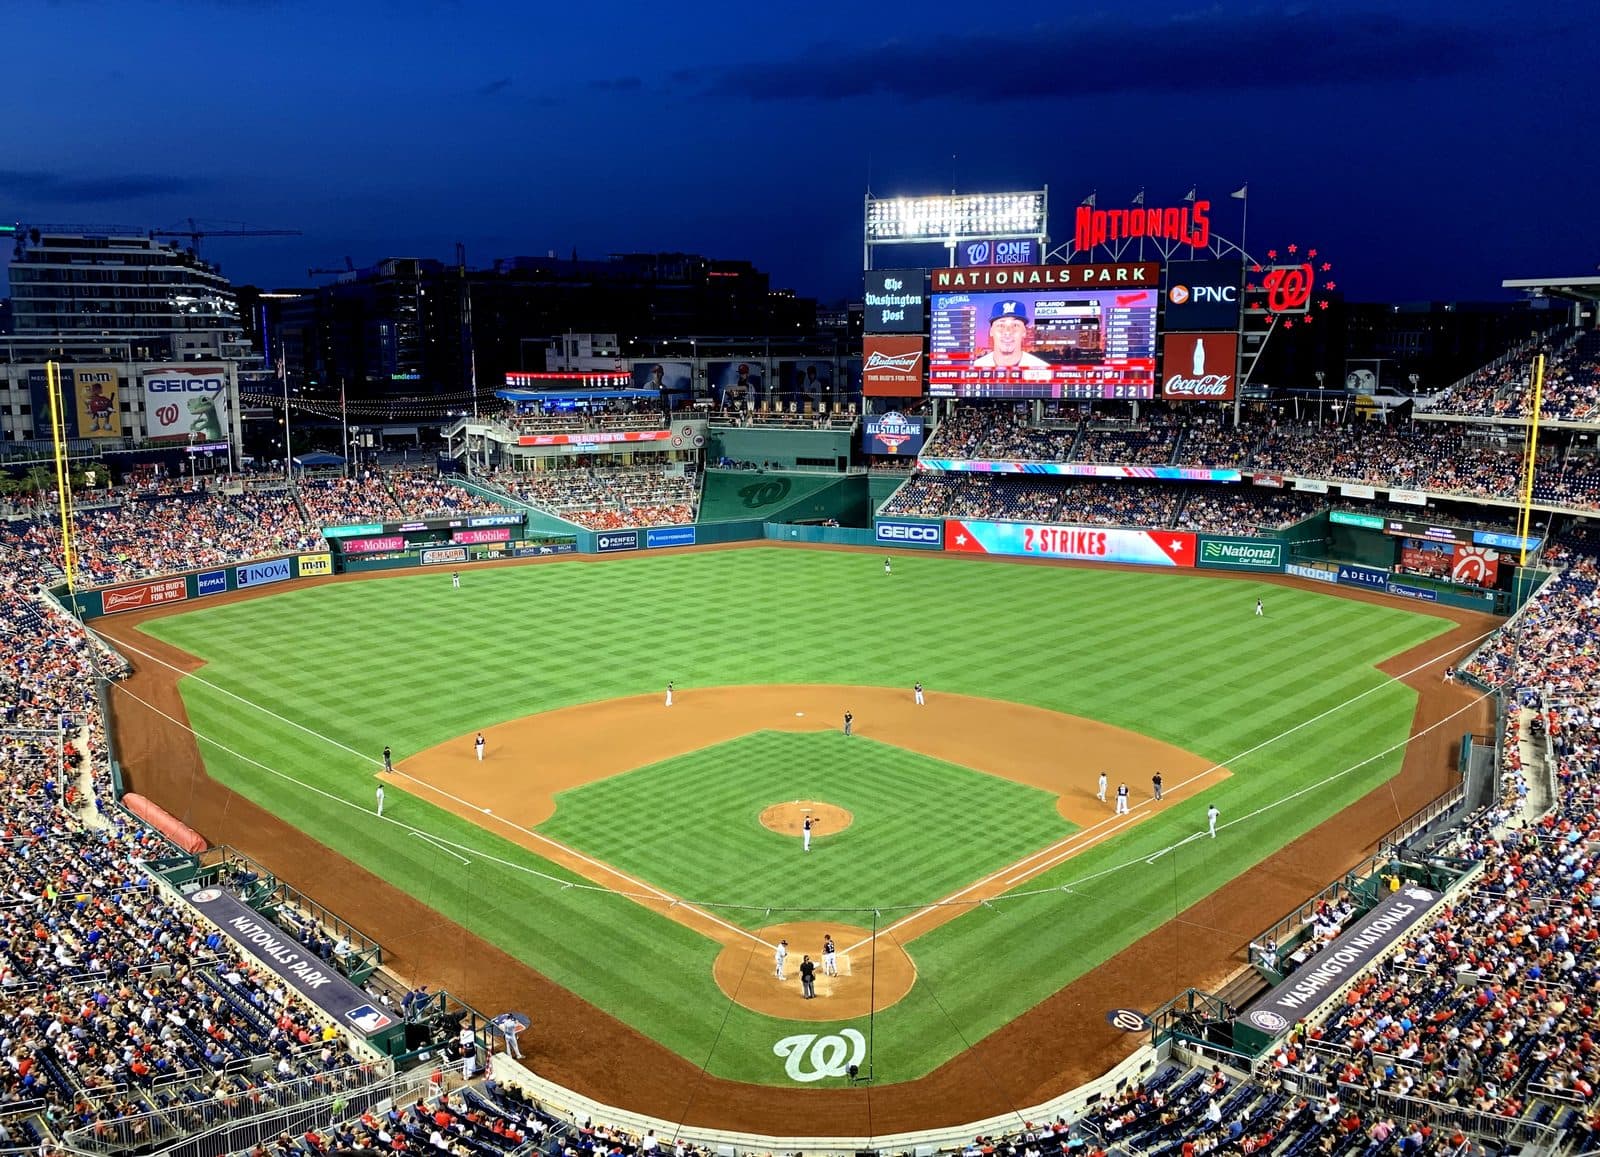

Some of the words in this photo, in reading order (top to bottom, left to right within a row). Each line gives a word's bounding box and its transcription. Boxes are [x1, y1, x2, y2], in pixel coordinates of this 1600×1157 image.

[1075, 201, 1210, 251] NATIONALS
[997, 242, 1030, 254] ONE
[996, 254, 1030, 264] PURSUIT
[938, 269, 1070, 286] NATIONALS
[1084, 267, 1145, 282] PARK
[884, 278, 903, 291] The
[865, 293, 922, 307] Washington
[1192, 286, 1236, 302] PNC
[881, 309, 905, 324] Post
[867, 355, 917, 367] Budweiser
[148, 379, 221, 393] GEICO
[901, 425, 920, 435] GAME
[878, 525, 938, 540] GEICO
[1024, 528, 1033, 551] 2
[1040, 529, 1106, 556] STRIKES
[1221, 545, 1276, 559] National
[251, 565, 289, 581] INOVA
[1299, 566, 1334, 580] KOCH
[1351, 571, 1385, 584] DELTA
[150, 584, 164, 593] THIS
[165, 580, 185, 591] BUD'S
[199, 576, 225, 587] RE/MAX
[150, 593, 162, 601] FOR
[228, 915, 302, 966] NATIONALS
[288, 957, 332, 989] PARK
[1277, 944, 1360, 1009] WASHINGTON
[1353, 902, 1416, 957] NATIONALS
